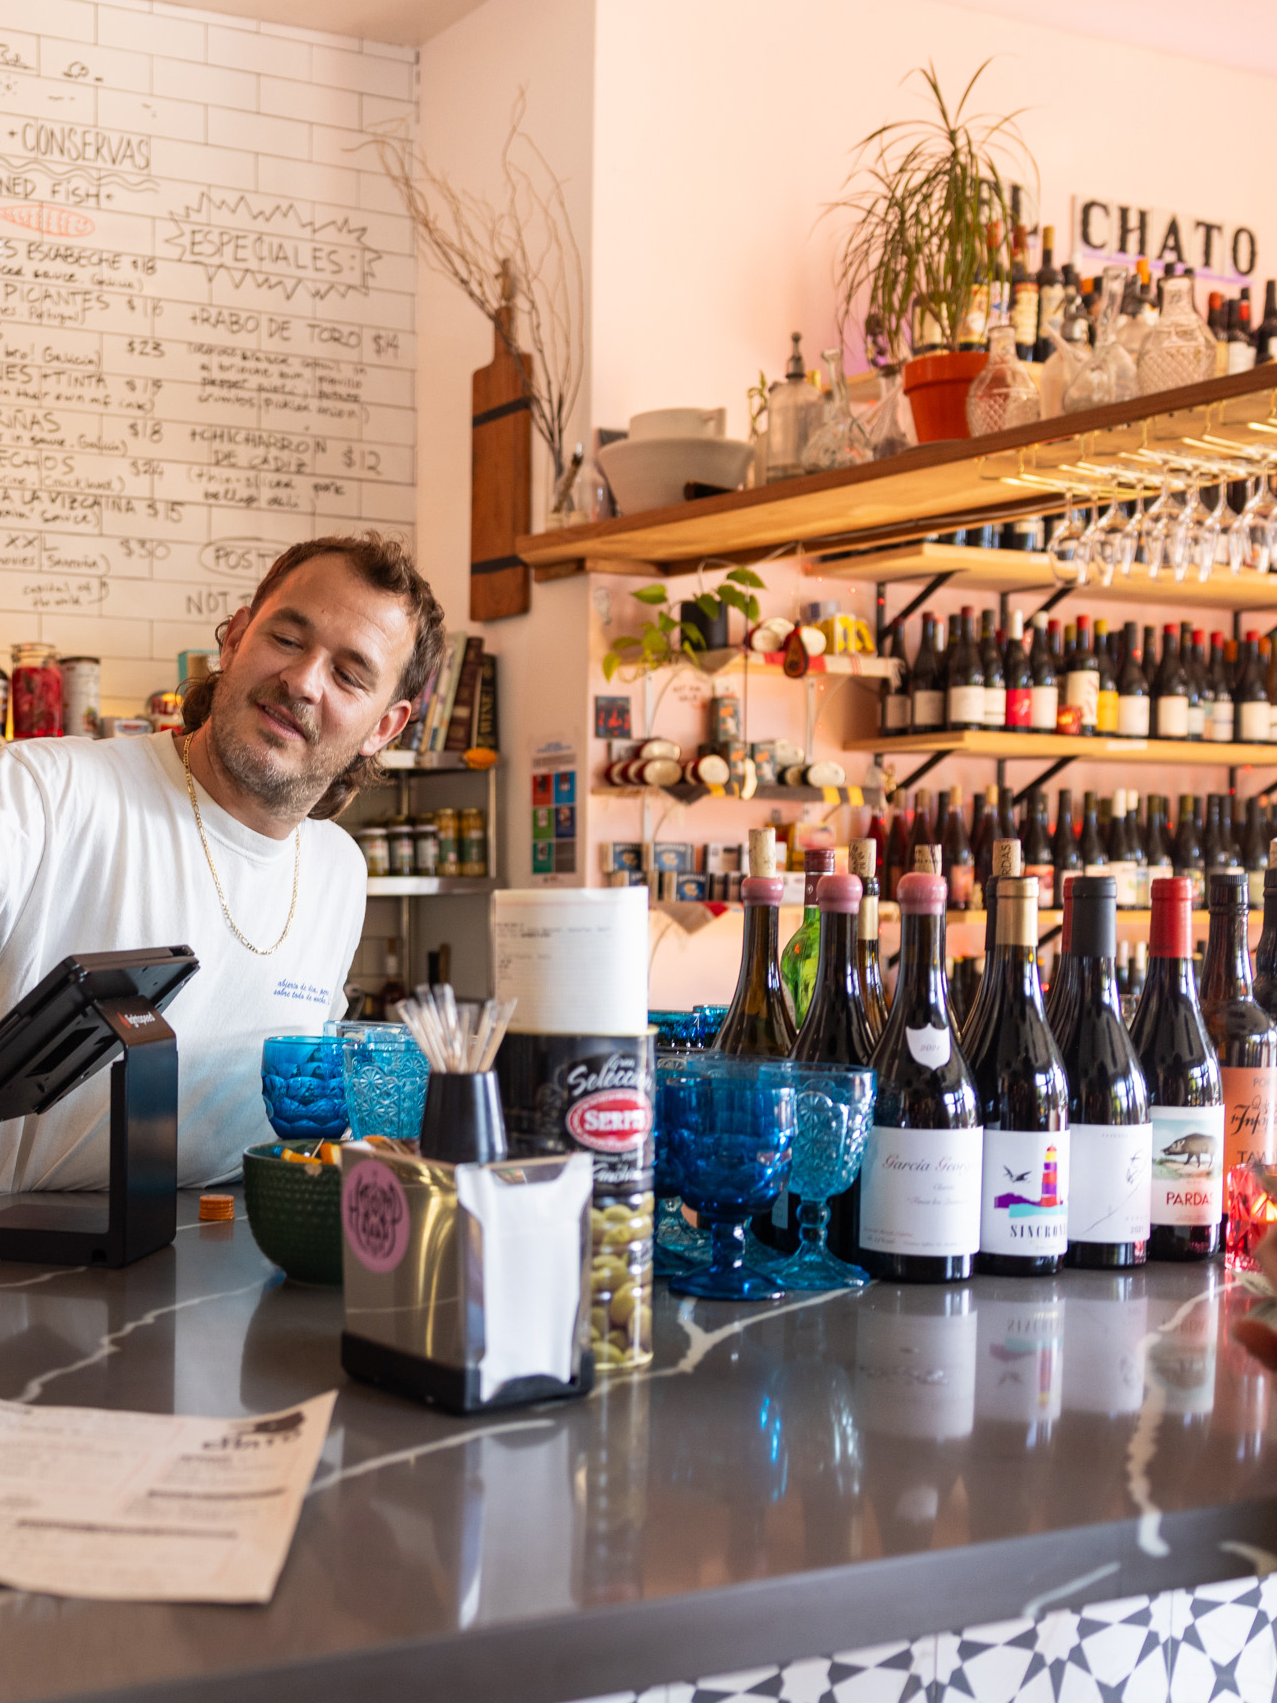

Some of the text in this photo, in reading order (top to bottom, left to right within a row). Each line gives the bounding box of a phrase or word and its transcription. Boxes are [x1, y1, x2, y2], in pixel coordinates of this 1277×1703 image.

[22, 121, 151, 171] CONSERVAS
[190, 228, 357, 275] ESPECIALES:
[1081, 200, 1256, 275] CHATO
[4, 283, 110, 313] PICANTES
[267, 317, 292, 342] DE
[307, 323, 362, 349] TORO
[126, 340, 165, 358] $23
[128, 421, 164, 444] $18
[214, 449, 237, 467] DE
[343, 445, 382, 476] $12
[2, 487, 14, 504] A
[23, 489, 44, 506] LA
[146, 500, 184, 524] $15
[5, 533, 59, 551] XXL
[120, 538, 172, 561] $30
[215, 546, 282, 570] POST
[186, 590, 229, 616] NOT
[882, 1154, 930, 1172] García
